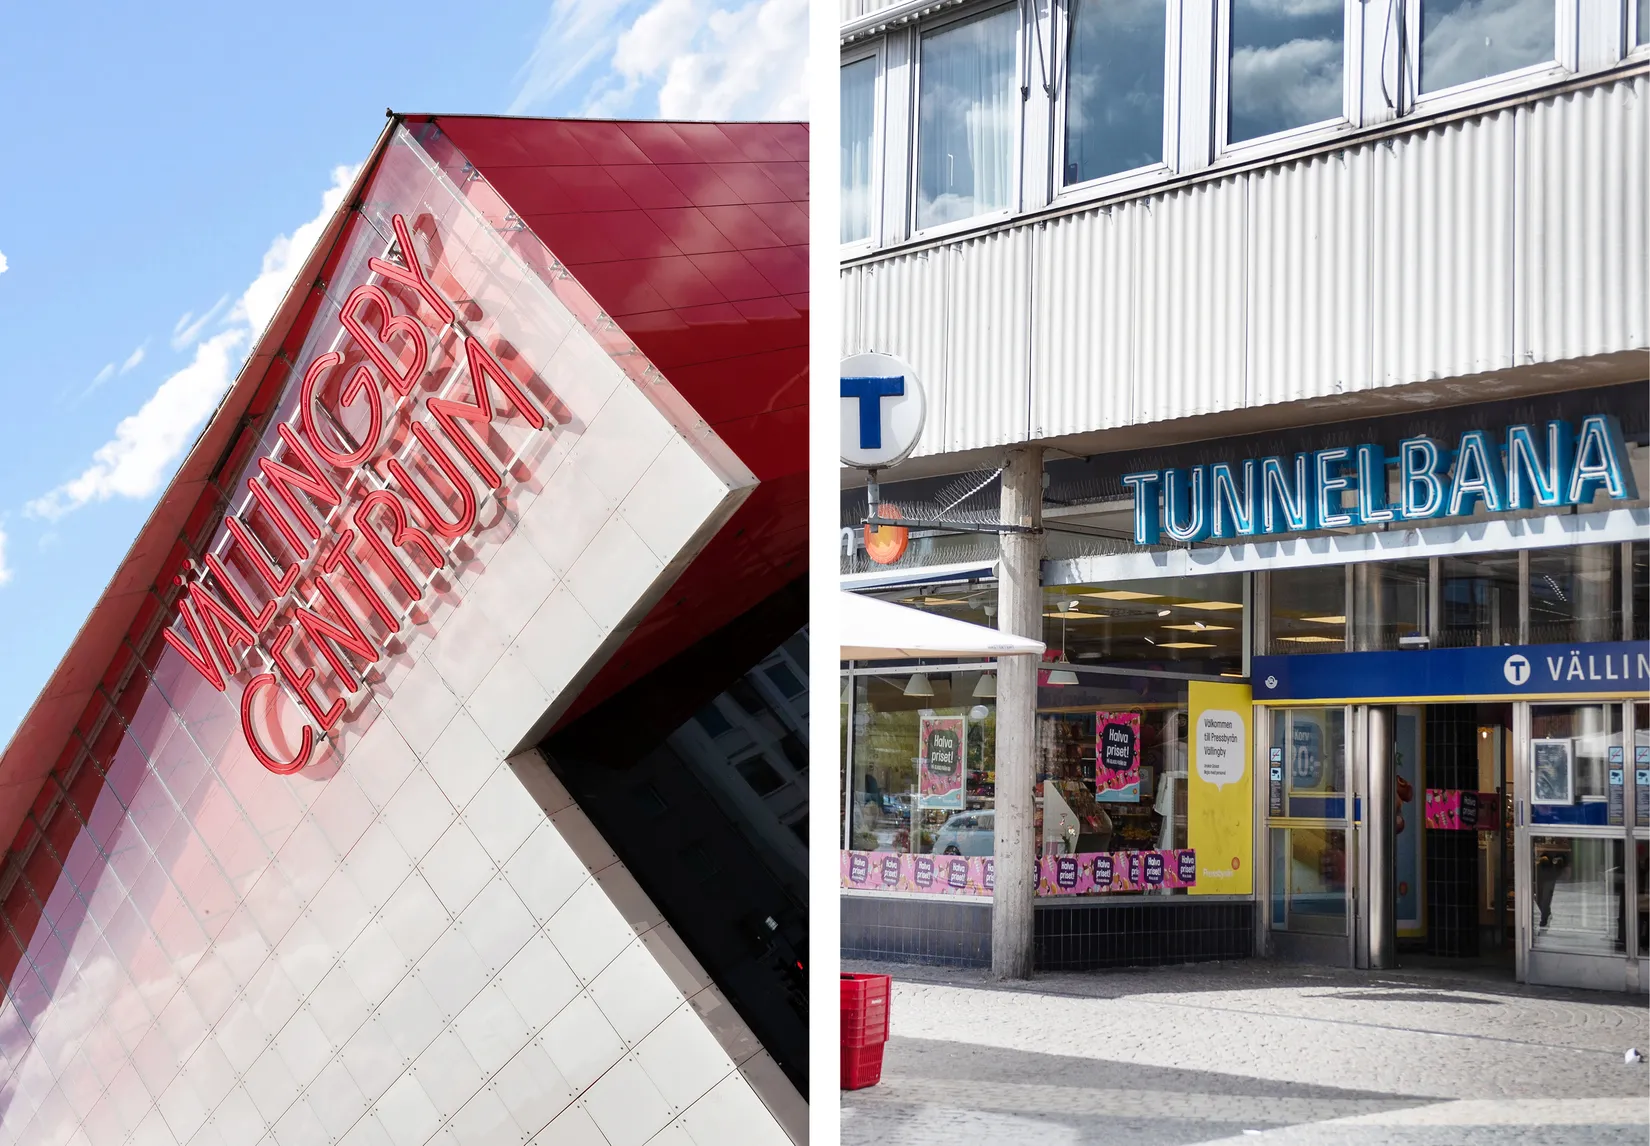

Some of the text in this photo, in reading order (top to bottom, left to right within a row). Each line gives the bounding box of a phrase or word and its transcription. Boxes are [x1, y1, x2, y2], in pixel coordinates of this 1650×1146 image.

[839, 374, 905, 449] T
[163, 213, 456, 692] VÄLLINGBY
[1121, 413, 1632, 546] TUNNELBANA
[240, 336, 546, 776] CENTRUM
[1204, 719, 1233, 729] Välkommen
[934, 734, 953, 748] Halva
[1108, 728, 1129, 744] Halva
[1211, 733, 1238, 744] Pressbyrån
[931, 750, 954, 764] priset!
[1106, 744, 1130, 758] priset!
[1204, 746, 1227, 758] Vällingby
